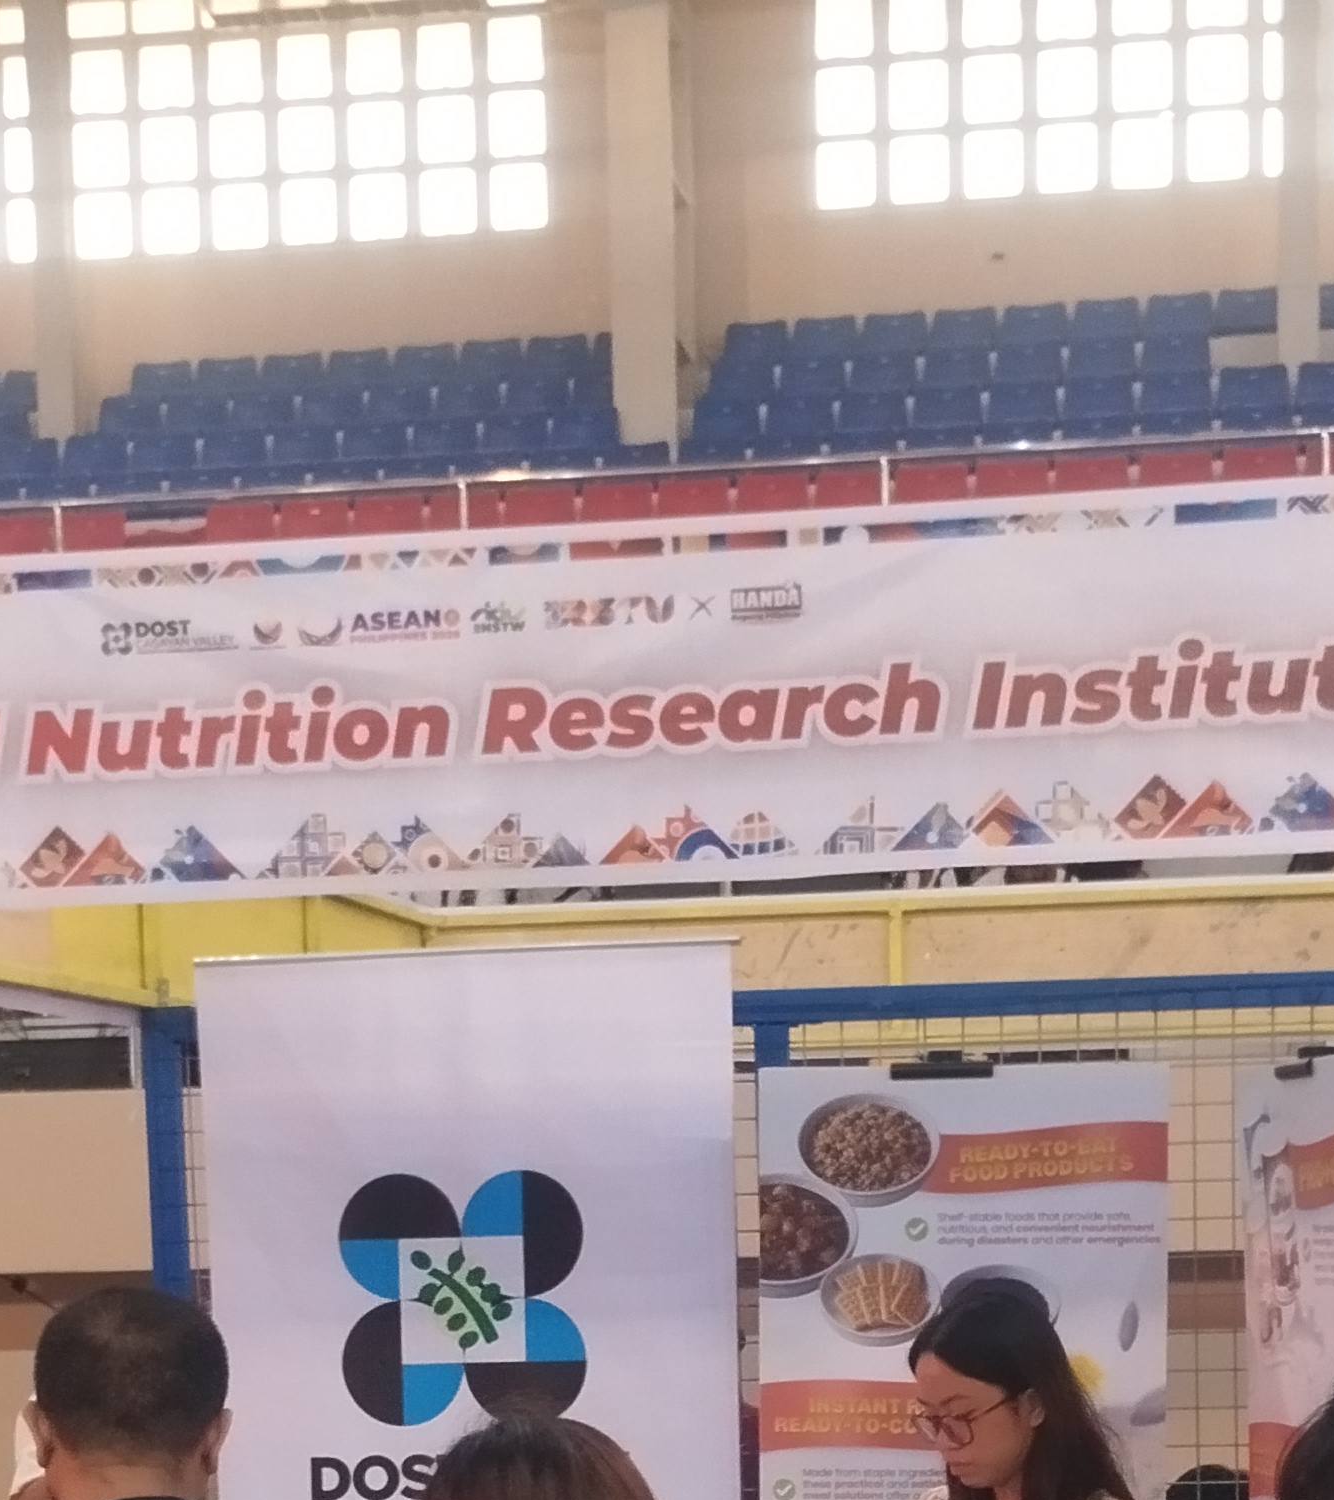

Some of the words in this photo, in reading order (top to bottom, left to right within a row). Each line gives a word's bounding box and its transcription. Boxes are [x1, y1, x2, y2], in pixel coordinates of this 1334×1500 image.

[135, 619, 190, 639] DOST
[350, 609, 440, 633] ASEAN
[25, 684, 450, 776] Nutrition
[481, 661, 941, 756] Research
[960, 1137, 1116, 1164] READY-TO-EAT
[949, 1163, 1008, 1183] FOOD
[1013, 1155, 1135, 1179] PRODUCTS
[809, 1399, 899, 1415] INSTANT
